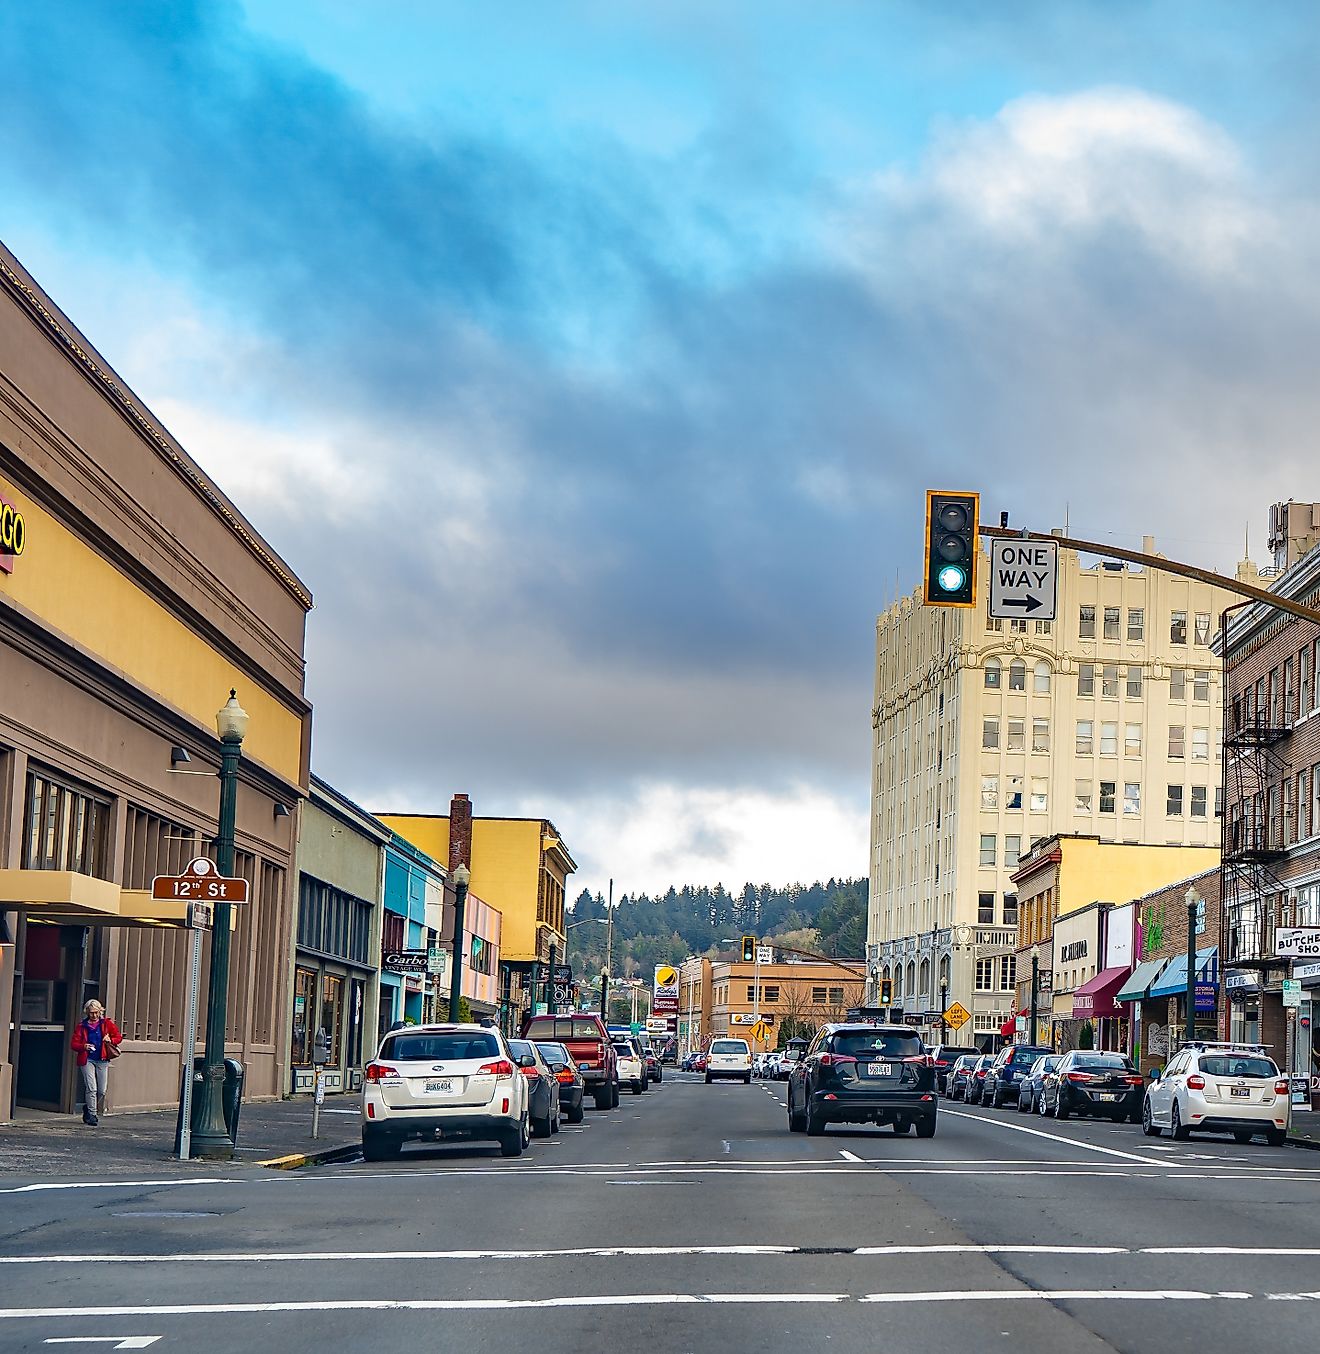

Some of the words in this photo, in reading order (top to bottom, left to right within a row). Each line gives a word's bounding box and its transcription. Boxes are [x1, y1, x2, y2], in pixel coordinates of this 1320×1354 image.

[0, 499, 26, 554] GO
[1001, 547, 1048, 567] ONE
[999, 570, 1050, 589] WAY
[173, 881, 200, 896] 12th
[208, 882, 227, 897] St
